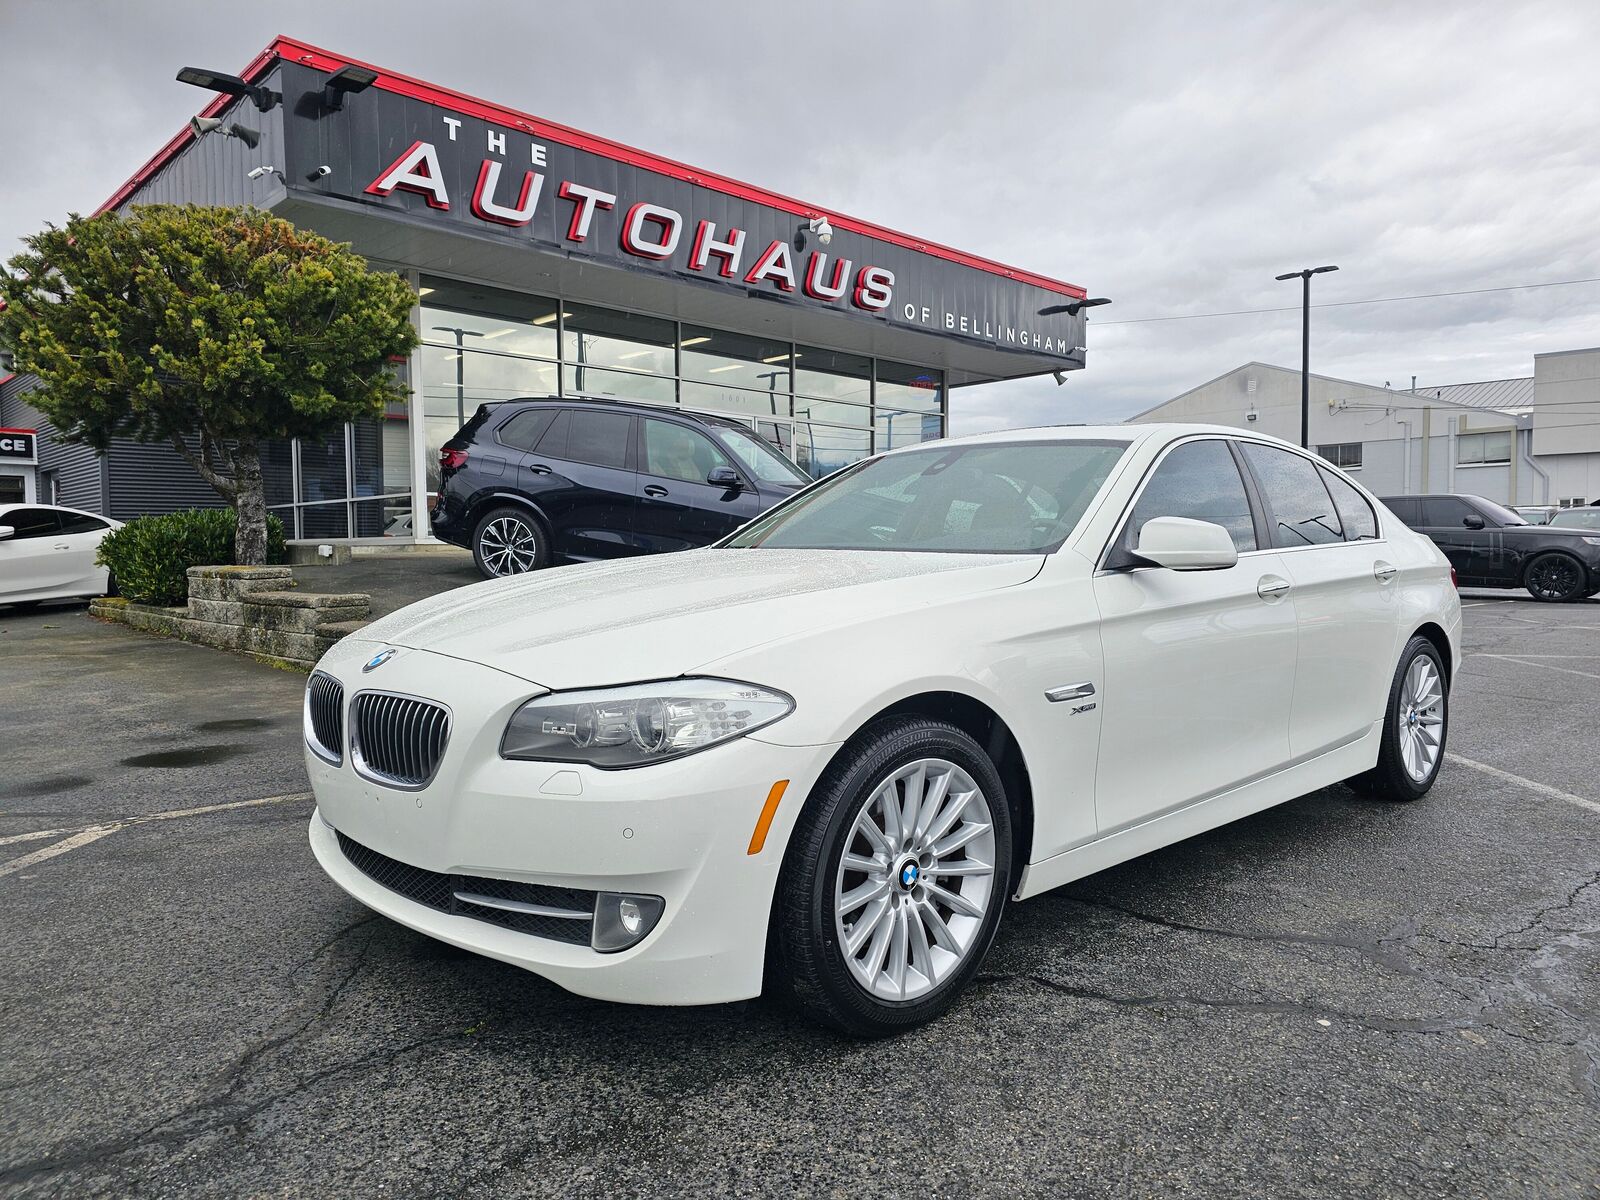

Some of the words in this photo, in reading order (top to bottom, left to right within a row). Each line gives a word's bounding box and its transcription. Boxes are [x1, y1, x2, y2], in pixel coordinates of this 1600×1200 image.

[443, 116, 547, 167] THE
[365, 140, 895, 311] AUTOHAUS
[904, 303, 931, 323] OF
[945, 313, 1067, 354] BELLINGHAM
